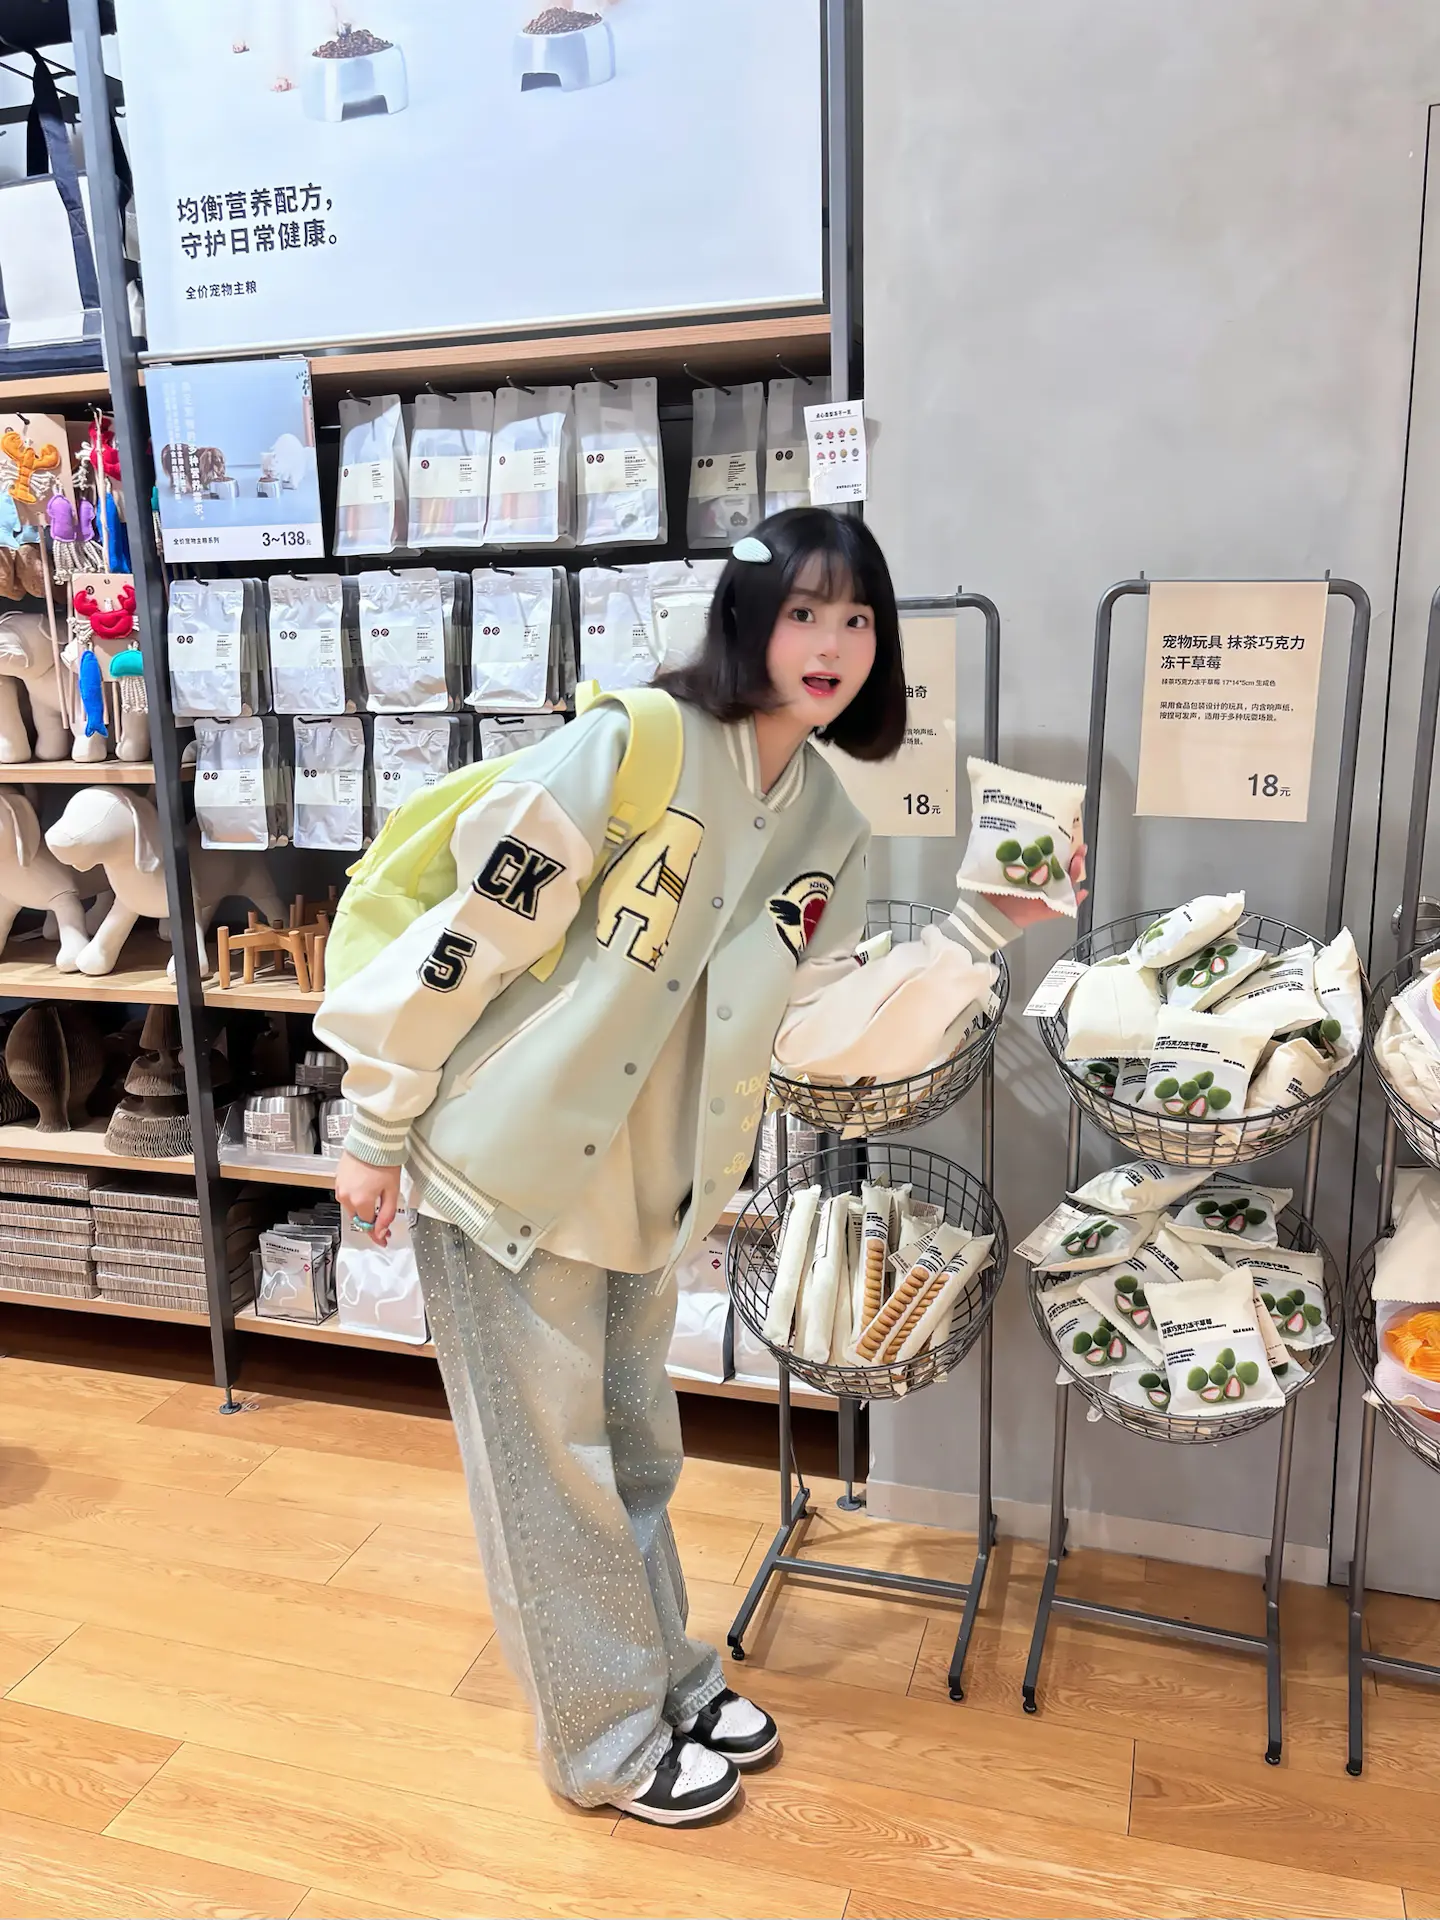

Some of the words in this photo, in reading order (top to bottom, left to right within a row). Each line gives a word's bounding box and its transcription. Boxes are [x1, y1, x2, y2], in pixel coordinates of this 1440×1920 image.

[181, 218, 337, 260] 守护日常健康。
[185, 280, 257, 300] 全价宠物主粮
[1162, 634, 1223, 650] 宠物玩具
[1227, 634, 1305, 650] 抹茶巧克力
[1160, 655, 1222, 670] 冻干草莓
[1161, 678, 1220, 687] 抹茶巧克力冻干草莓
[472, 834, 567, 921] CK
[416, 927, 477, 993] 5
